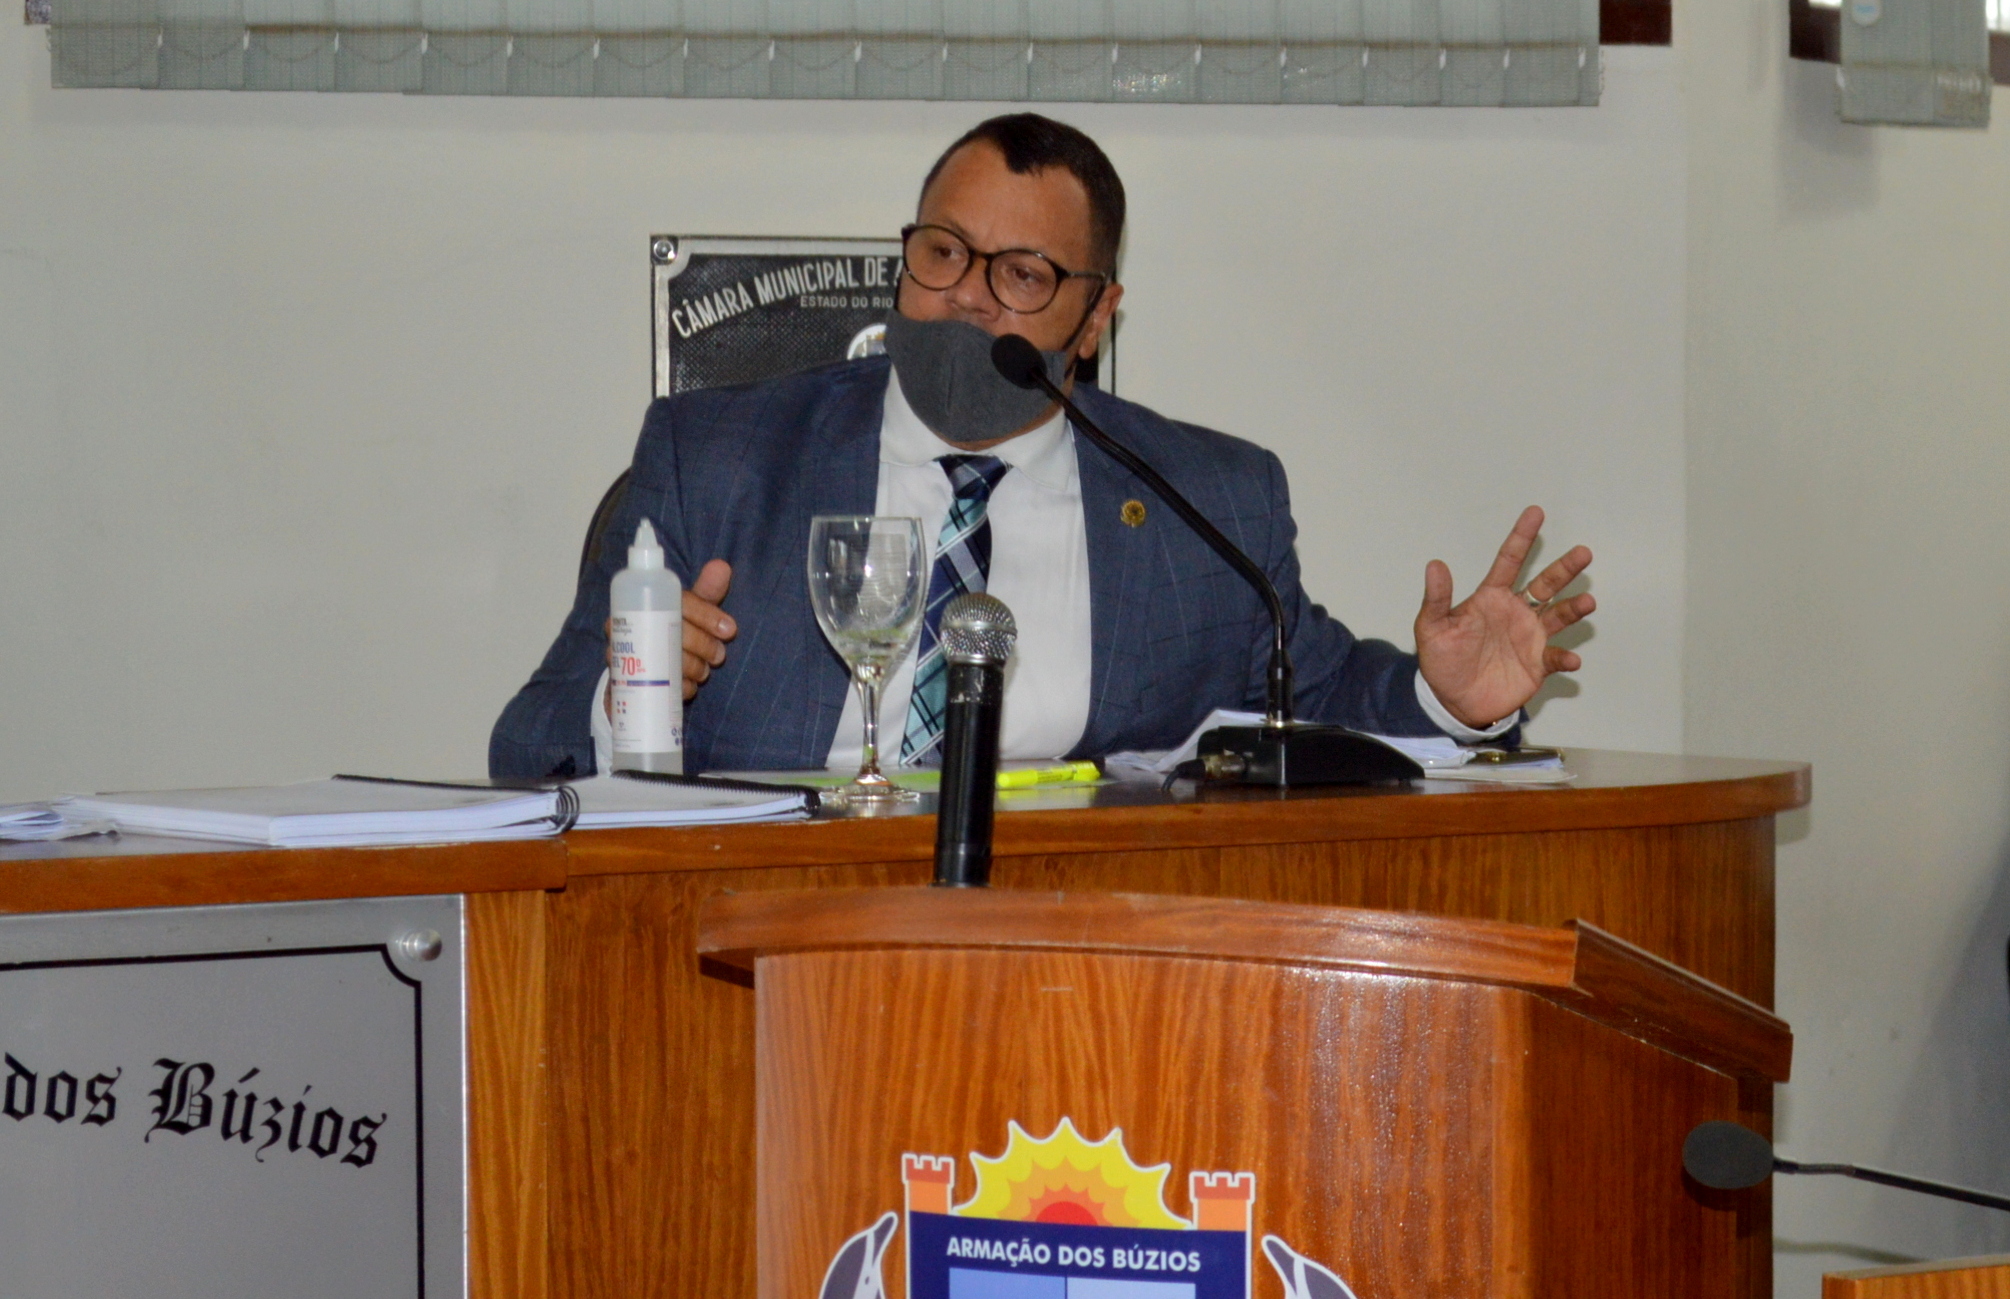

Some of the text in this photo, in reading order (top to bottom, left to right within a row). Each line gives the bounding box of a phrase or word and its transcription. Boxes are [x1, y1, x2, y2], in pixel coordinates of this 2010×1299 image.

[671, 281, 754, 339] CÂMARA
[754, 256, 860, 306] MUNICIPAL
[864, 257, 888, 287] DE
[800, 296, 895, 309] ESTADO DO RIO
[2, 1051, 388, 1169] dos Búzios
[946, 1236, 1201, 1272] ARMAÇÃO DOS BÚZIOS
